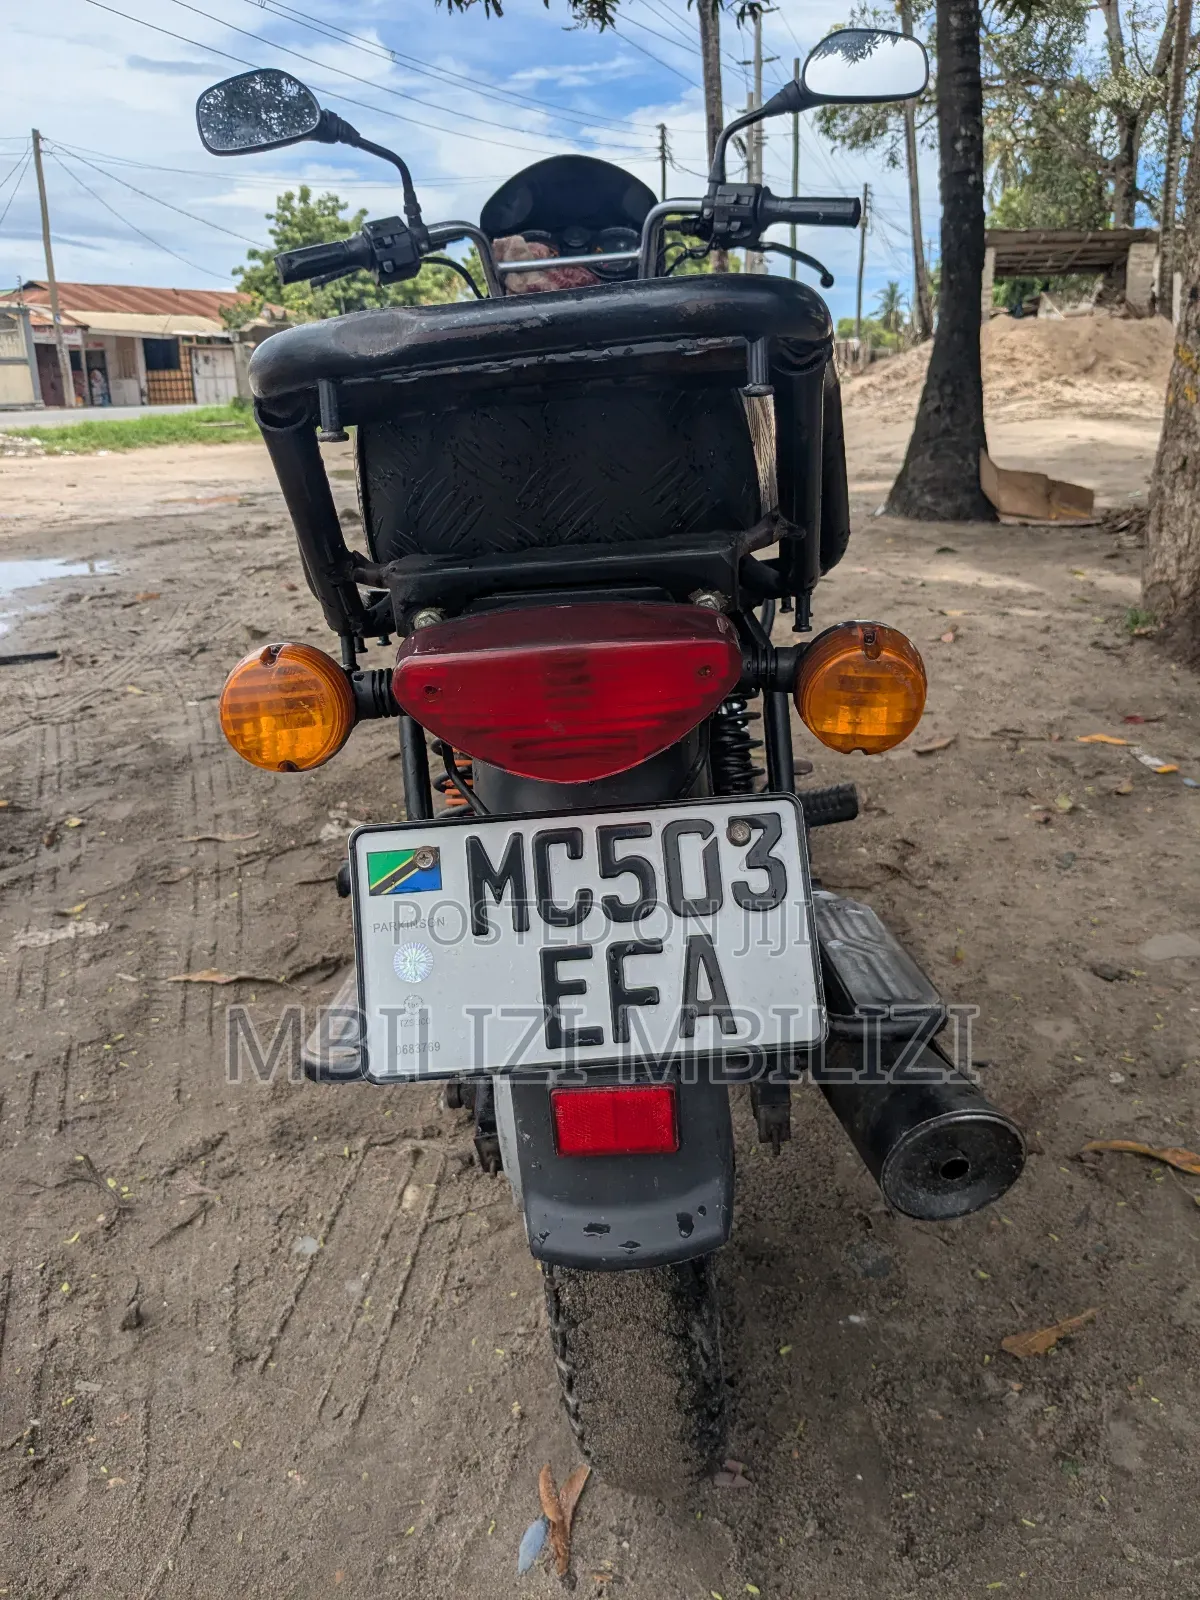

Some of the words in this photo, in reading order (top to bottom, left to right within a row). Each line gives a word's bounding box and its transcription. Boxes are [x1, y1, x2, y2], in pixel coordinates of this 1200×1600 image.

[373, 916, 446, 933] PARKINSON
[539, 934, 738, 1050] EFA
[395, 1041, 441, 1056] 0683769
